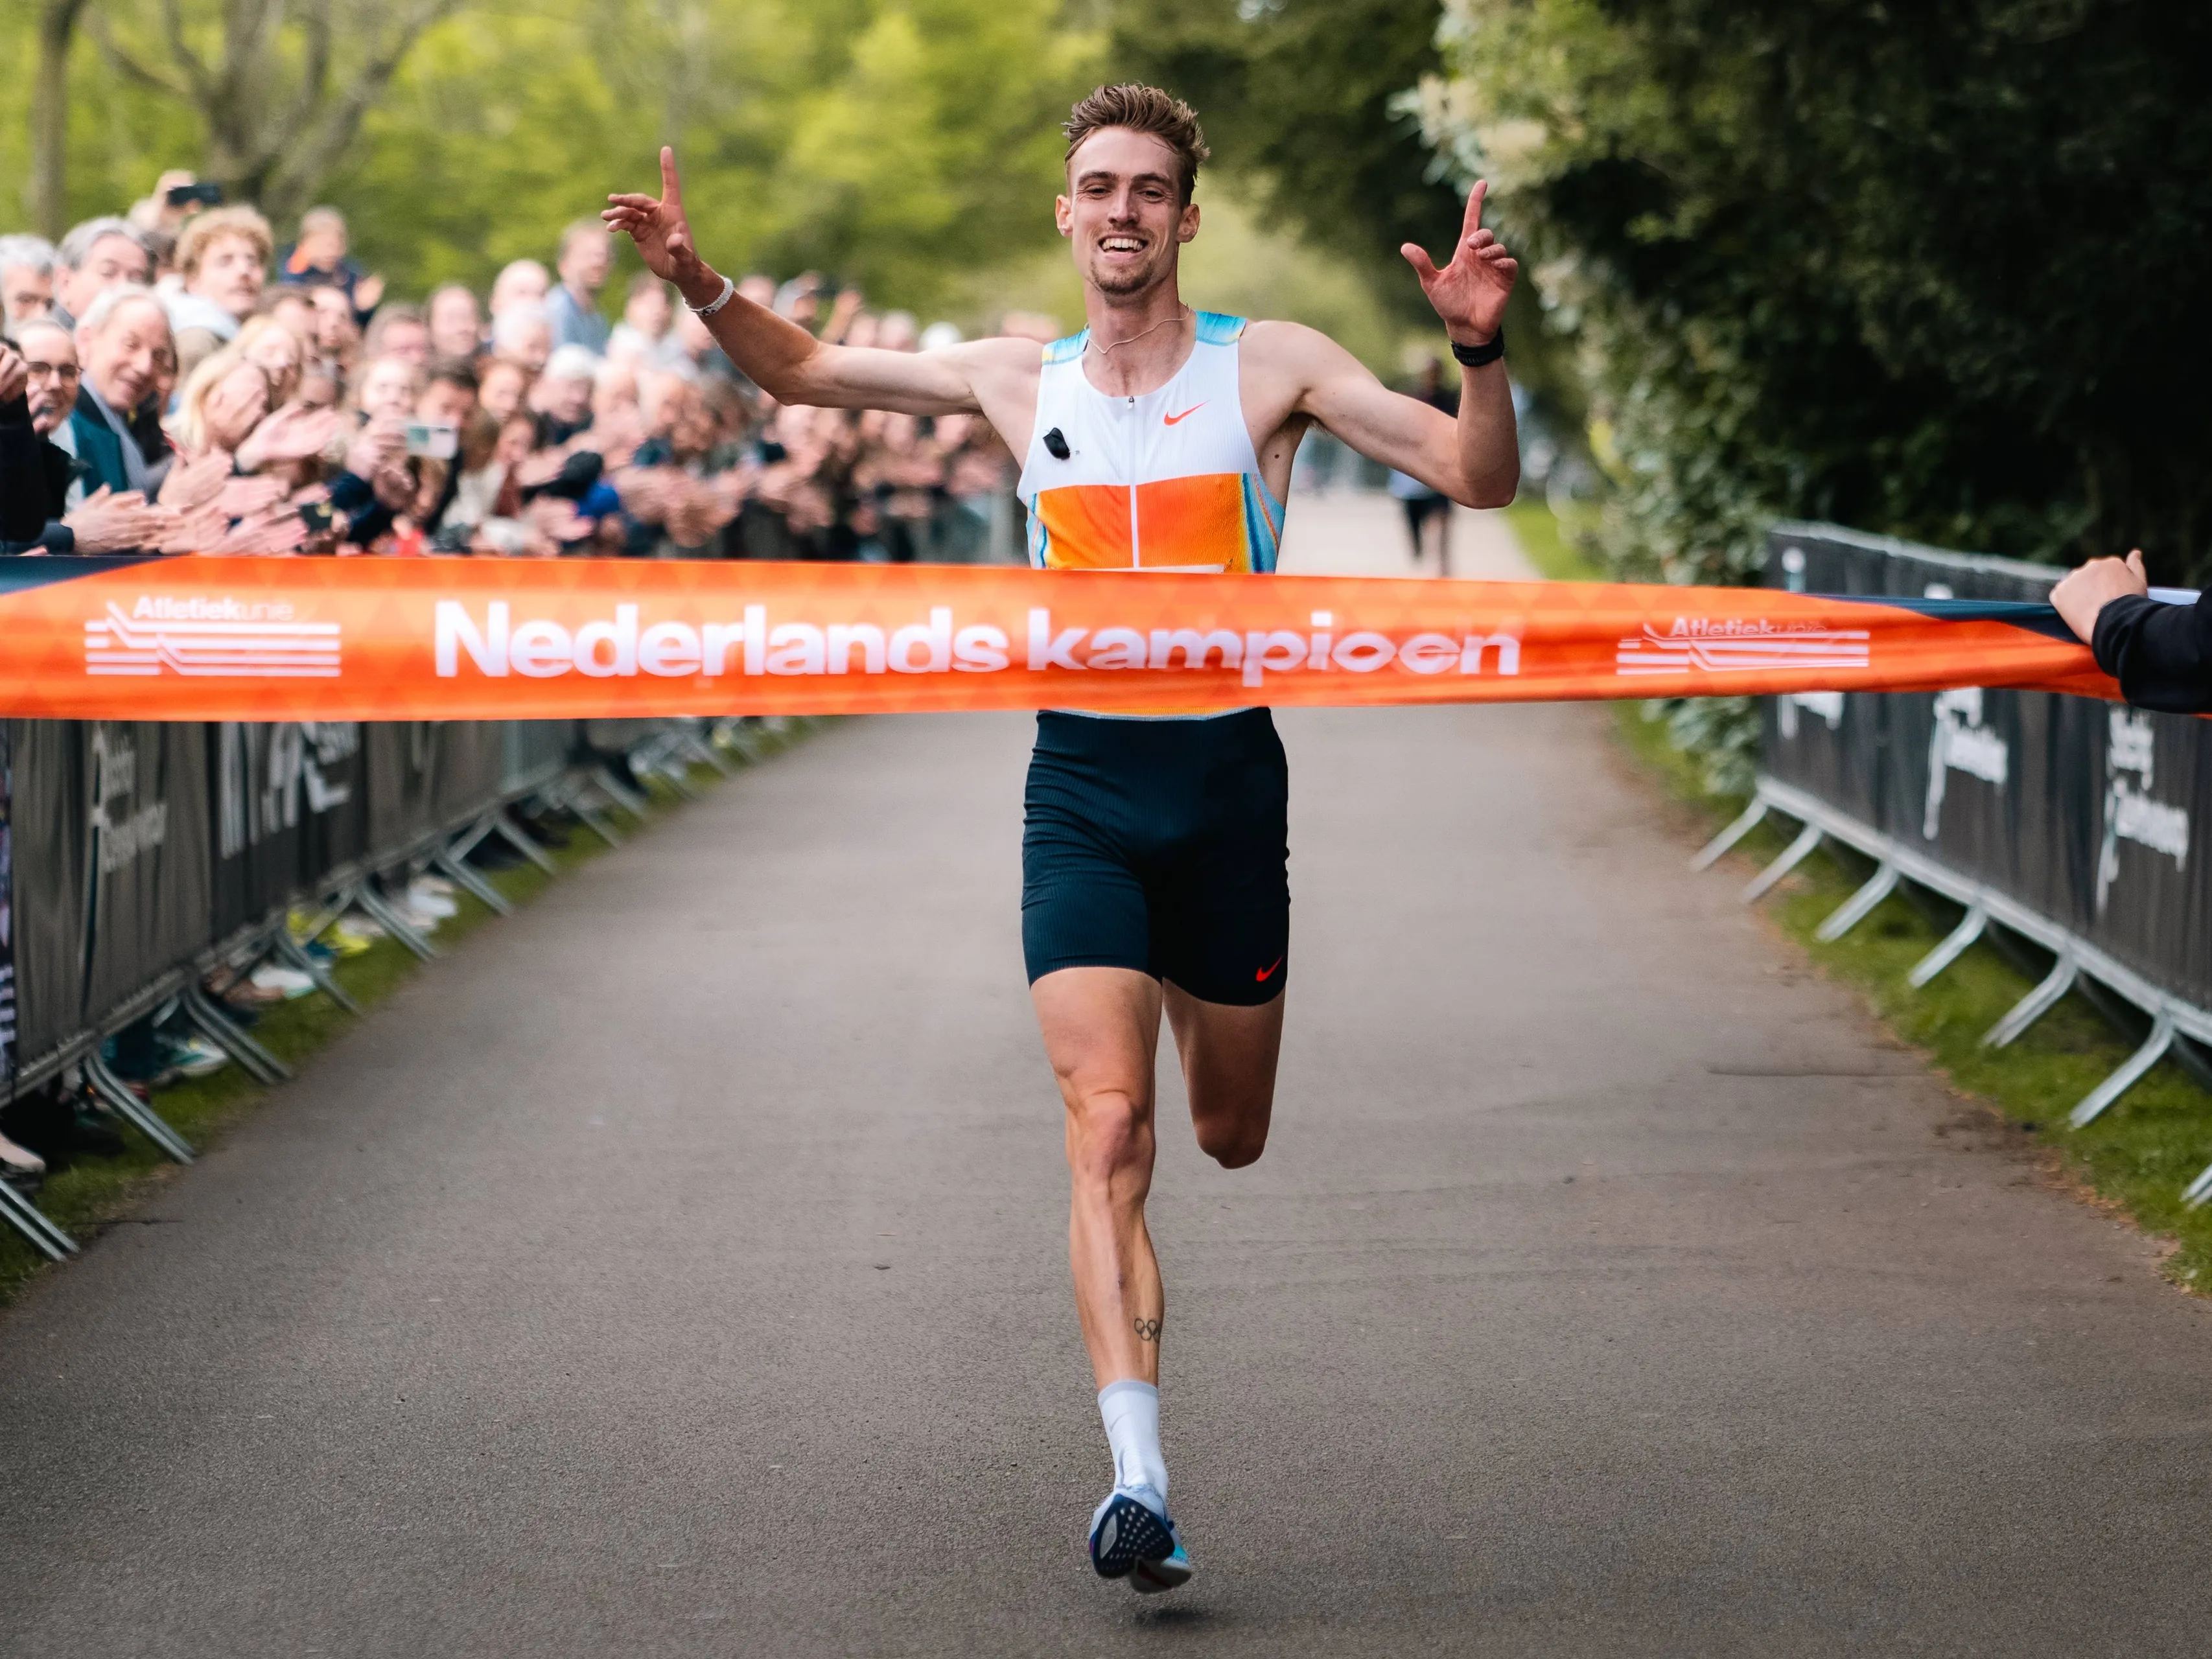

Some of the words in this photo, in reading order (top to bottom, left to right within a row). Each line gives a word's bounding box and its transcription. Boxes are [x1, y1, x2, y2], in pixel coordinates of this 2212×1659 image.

[132, 595, 294, 621] Atletiekunie
[435, 599, 1009, 678] Nederlands
[1027, 607, 1520, 688] kampioen
